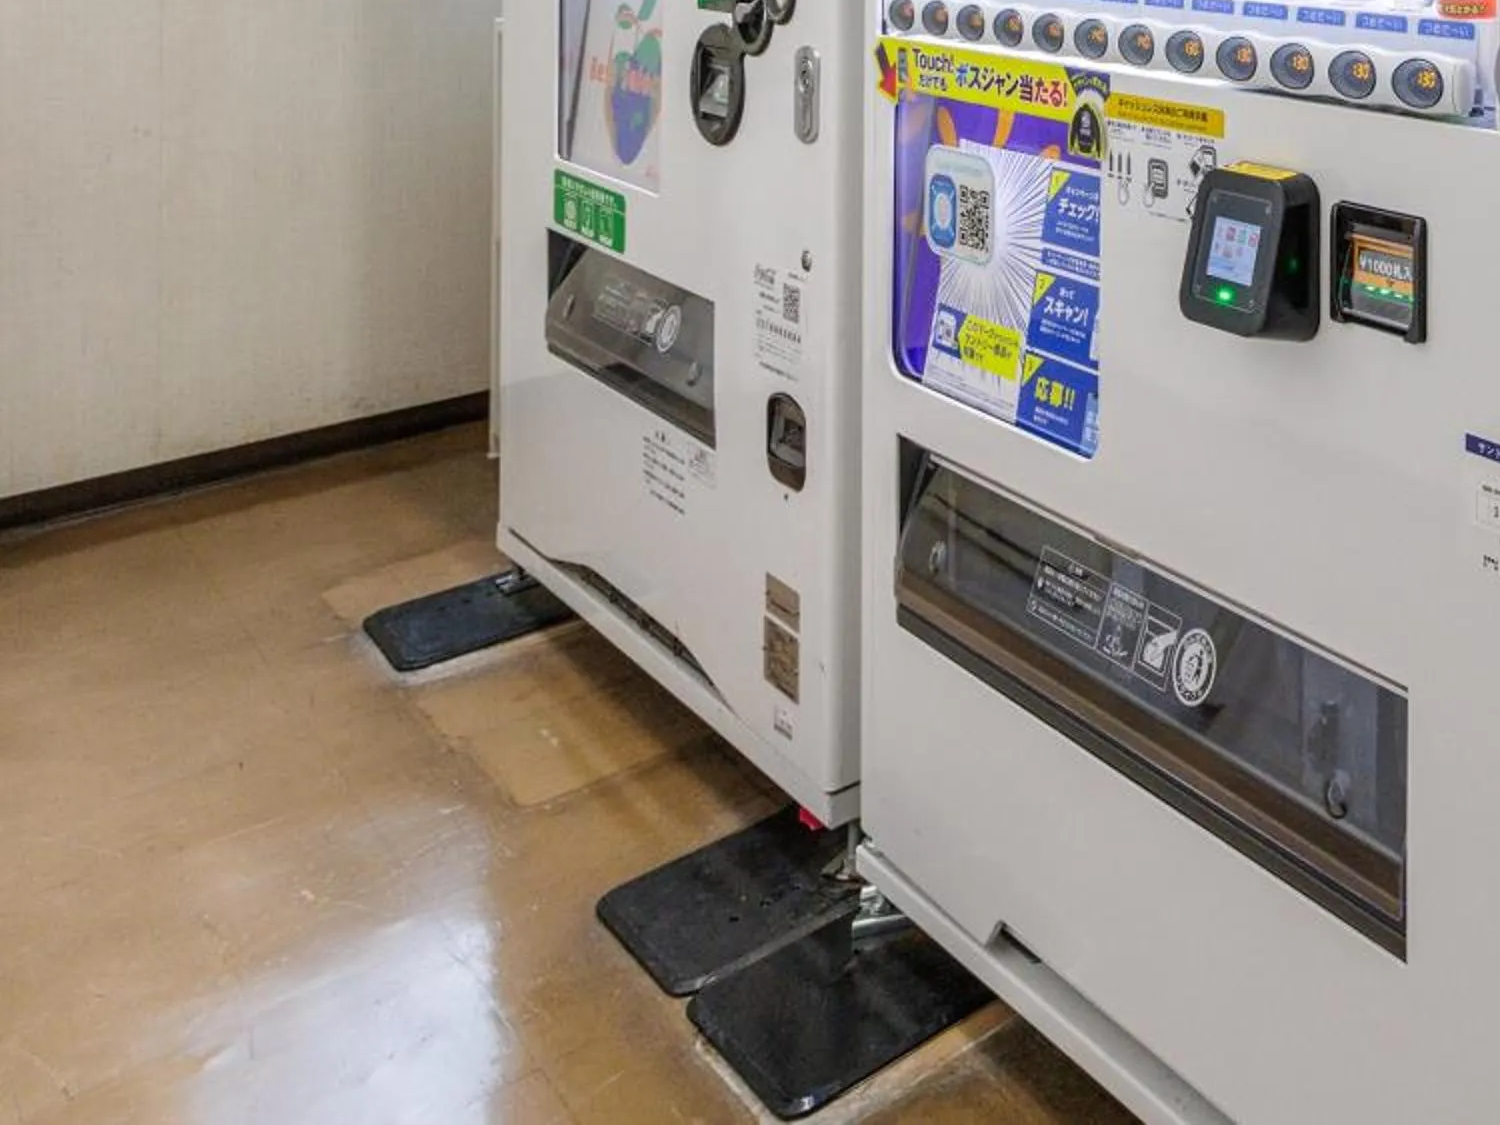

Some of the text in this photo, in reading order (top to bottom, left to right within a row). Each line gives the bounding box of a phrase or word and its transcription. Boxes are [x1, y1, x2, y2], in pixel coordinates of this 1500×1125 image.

[912, 48, 954, 73] Touch!
[955, 63, 1068, 108] ボスジャン当たる!
